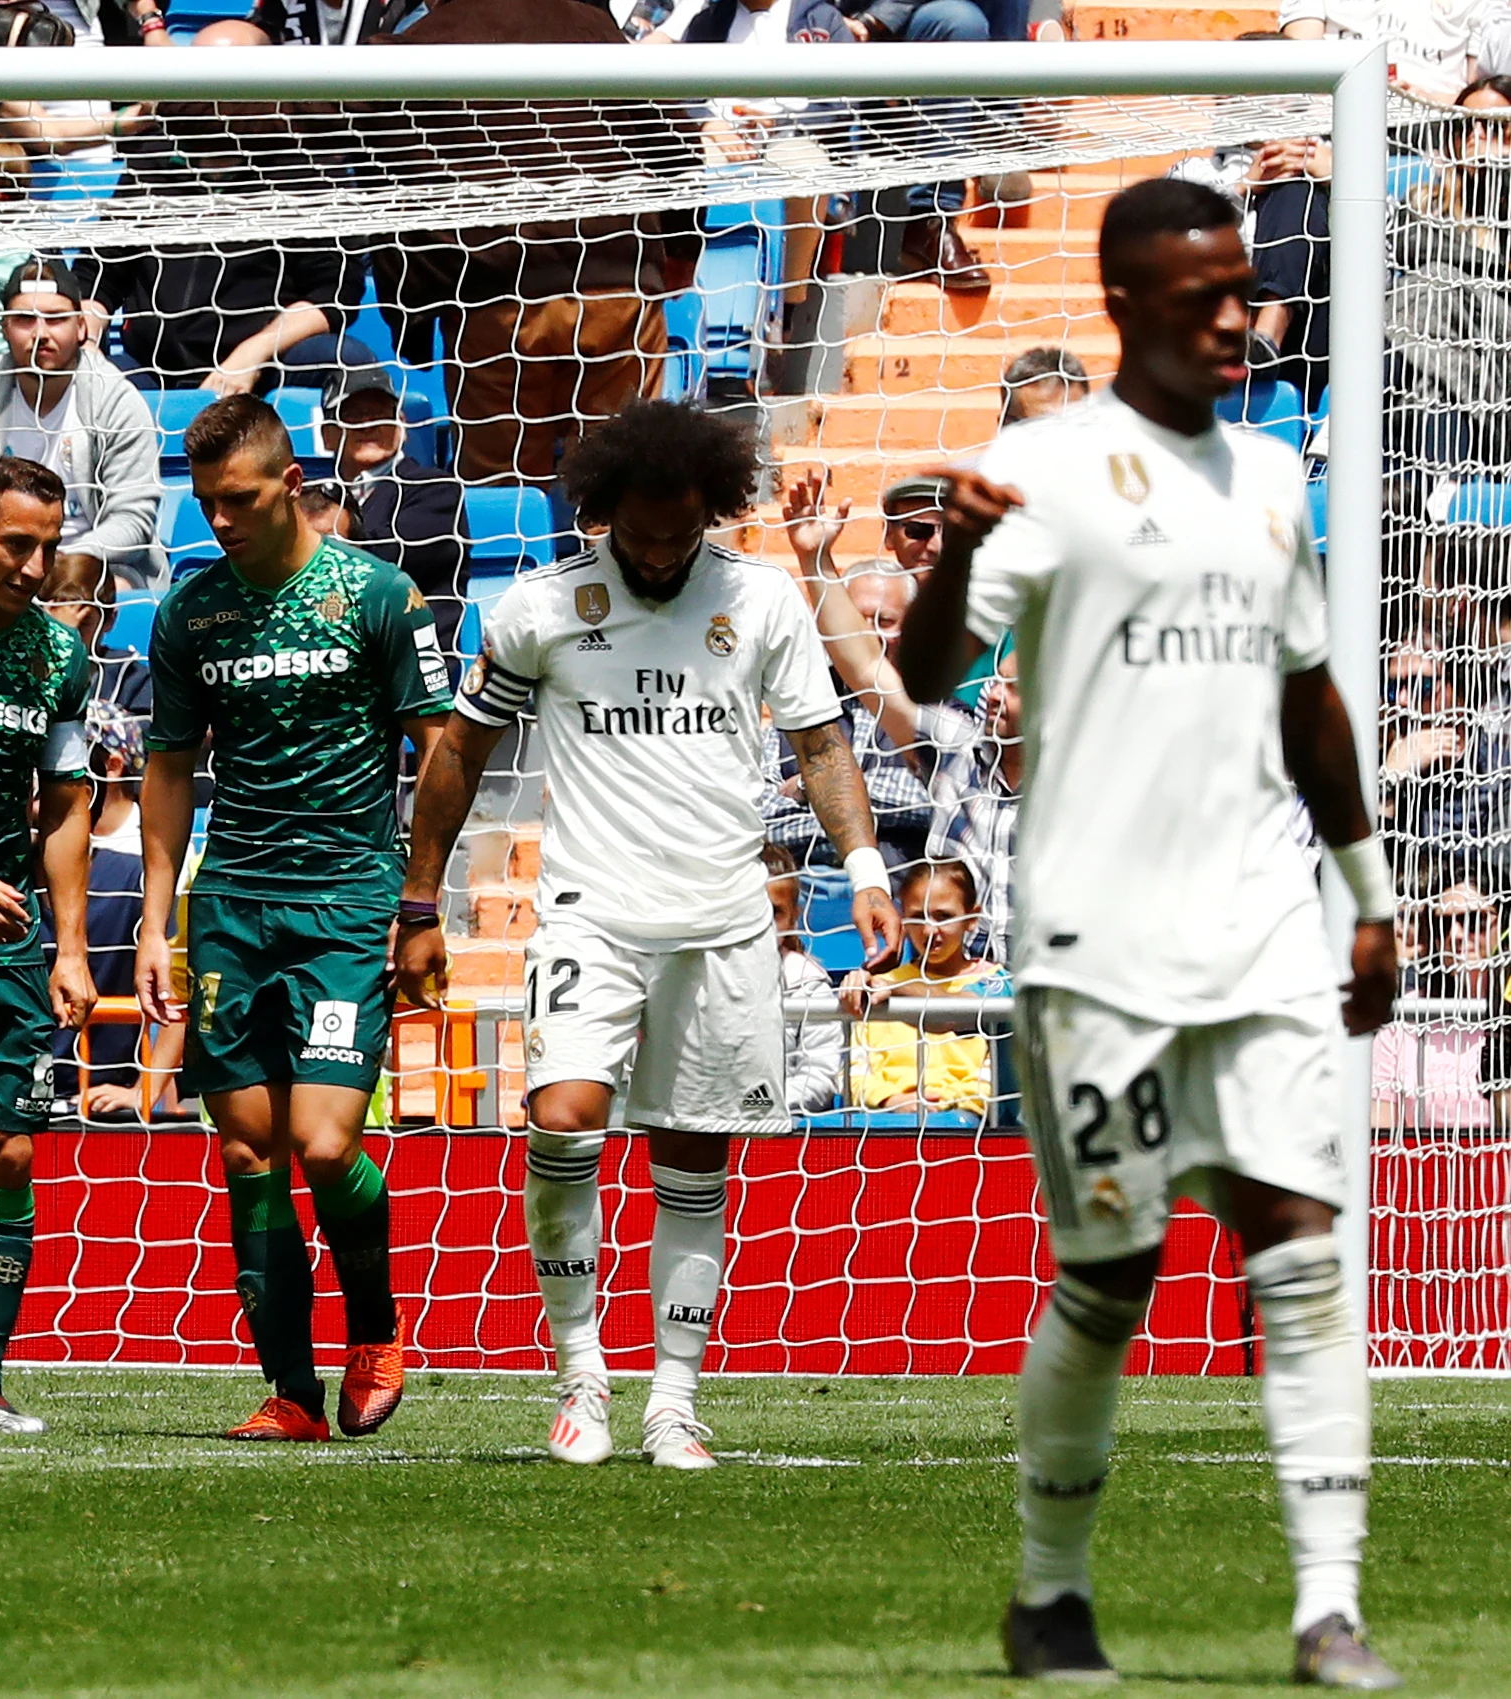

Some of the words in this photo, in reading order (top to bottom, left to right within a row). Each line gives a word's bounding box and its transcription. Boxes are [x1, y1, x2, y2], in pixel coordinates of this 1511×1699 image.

[577, 642, 612, 652] adidas
[201, 648, 350, 686] OTCDESKS
[635, 669, 686, 699] Fly
[577, 697, 739, 736] Emirates
[528, 957, 581, 1025] 12
[1068, 1067, 1172, 1168] 28
